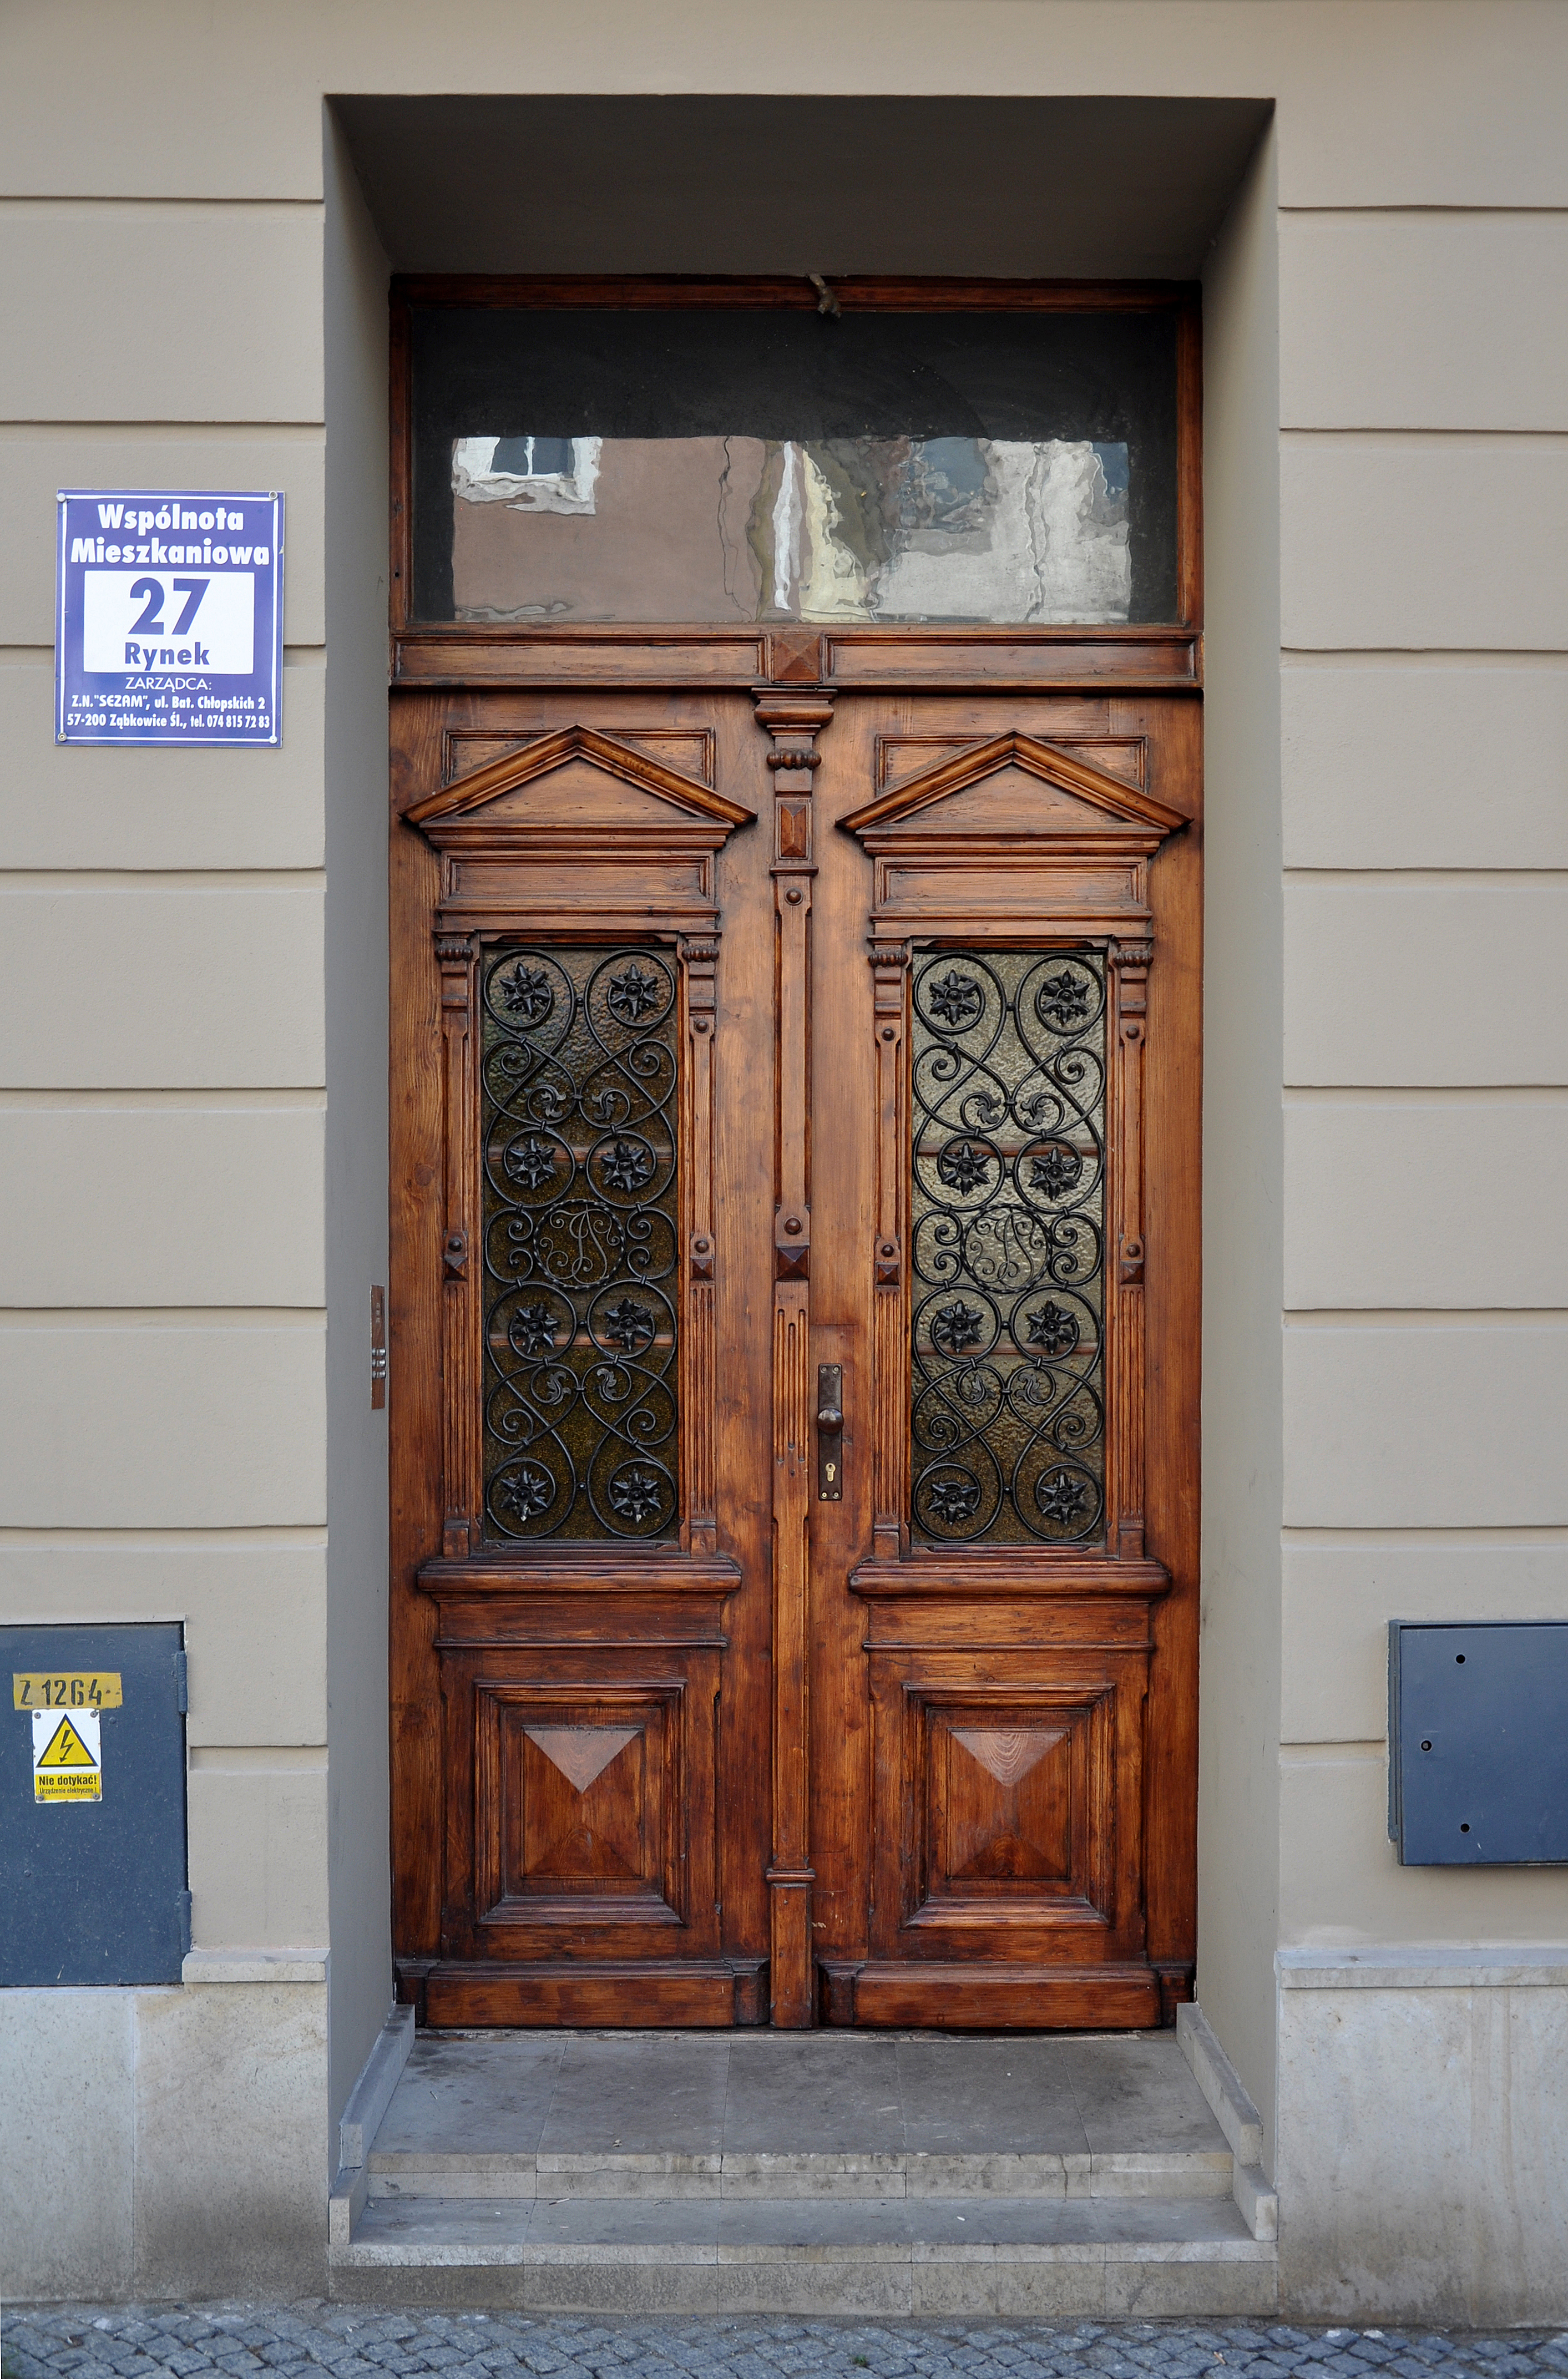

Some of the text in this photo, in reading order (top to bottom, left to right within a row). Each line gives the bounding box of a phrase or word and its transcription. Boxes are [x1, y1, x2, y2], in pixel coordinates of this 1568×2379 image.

[97, 503, 244, 536] Wspólnota
[70, 536, 270, 565] Mieszkaniowa
[128, 577, 211, 635] 27
[124, 641, 210, 671] Rynek
[124, 676, 213, 693] ZARZĄDCA:
[154, 695, 169, 708] ul.
[171, 695, 195, 708] Bat.
[197, 696, 255, 712] Chłopskich
[257, 696, 266, 710] 2
[67, 711, 270, 730] 57-200 Ząbkowice Śl., tel. 074 815 72 83
[41, 1679, 102, 1706] 1264
[39, 1774, 97, 1786] Nie dotykać!
